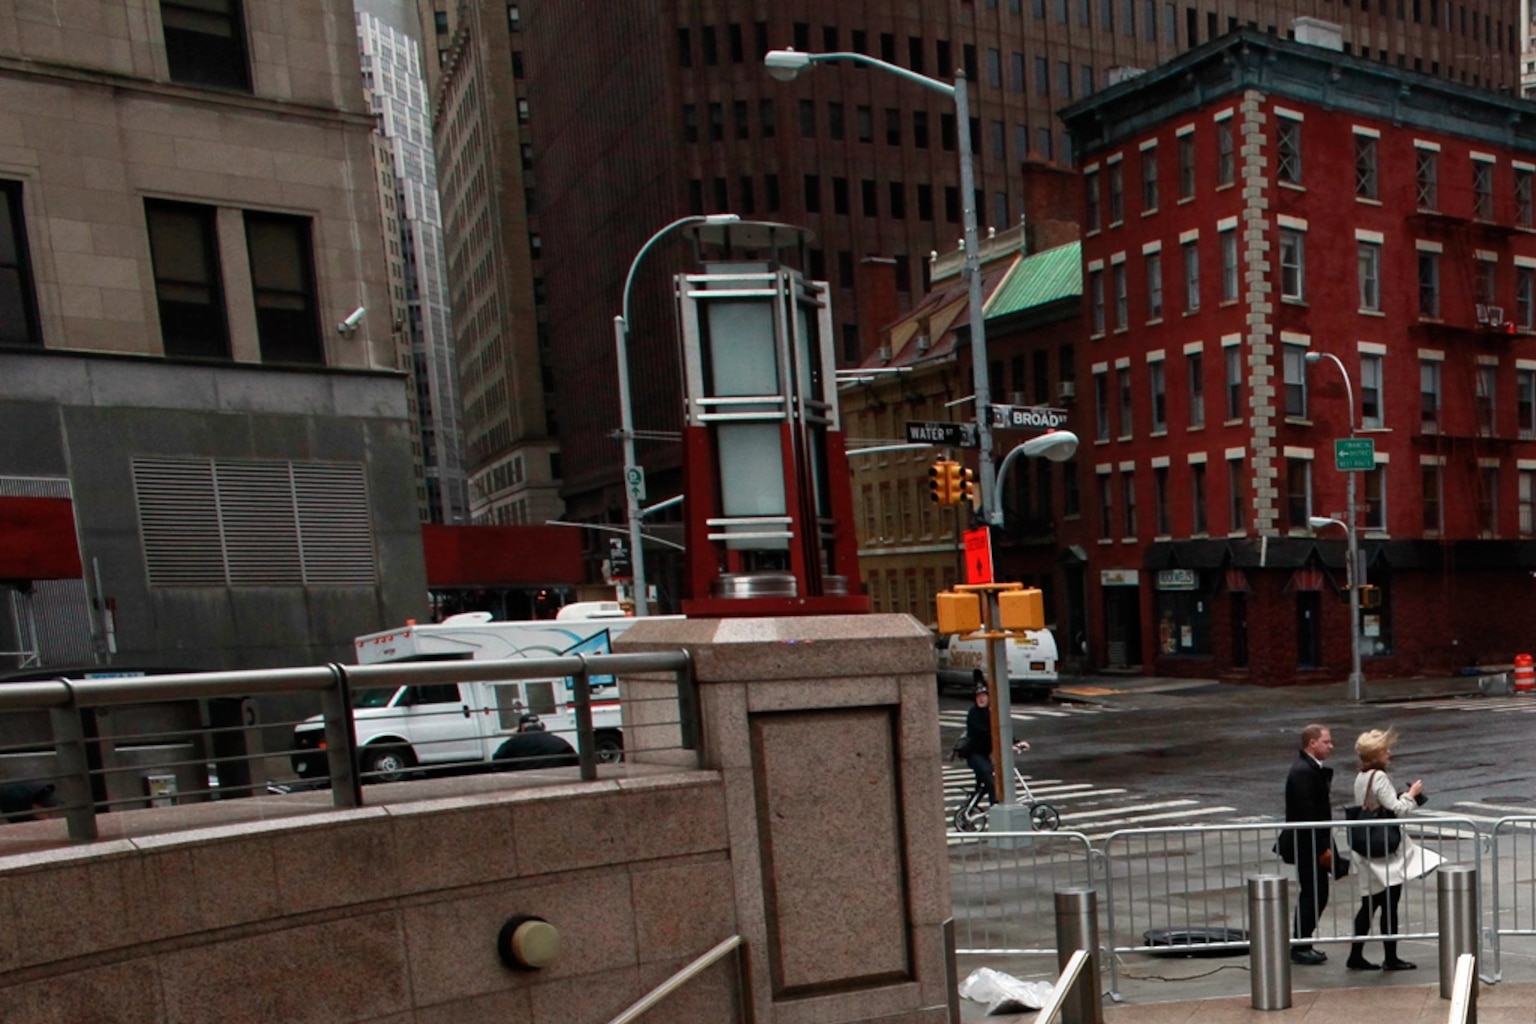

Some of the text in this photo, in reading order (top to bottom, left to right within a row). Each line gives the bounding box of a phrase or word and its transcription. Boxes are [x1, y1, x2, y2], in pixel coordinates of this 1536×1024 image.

[1013, 411, 1058, 427] BROAD
[910, 426, 953, 441] WATER ST
[950, 644, 983, 668] Service
